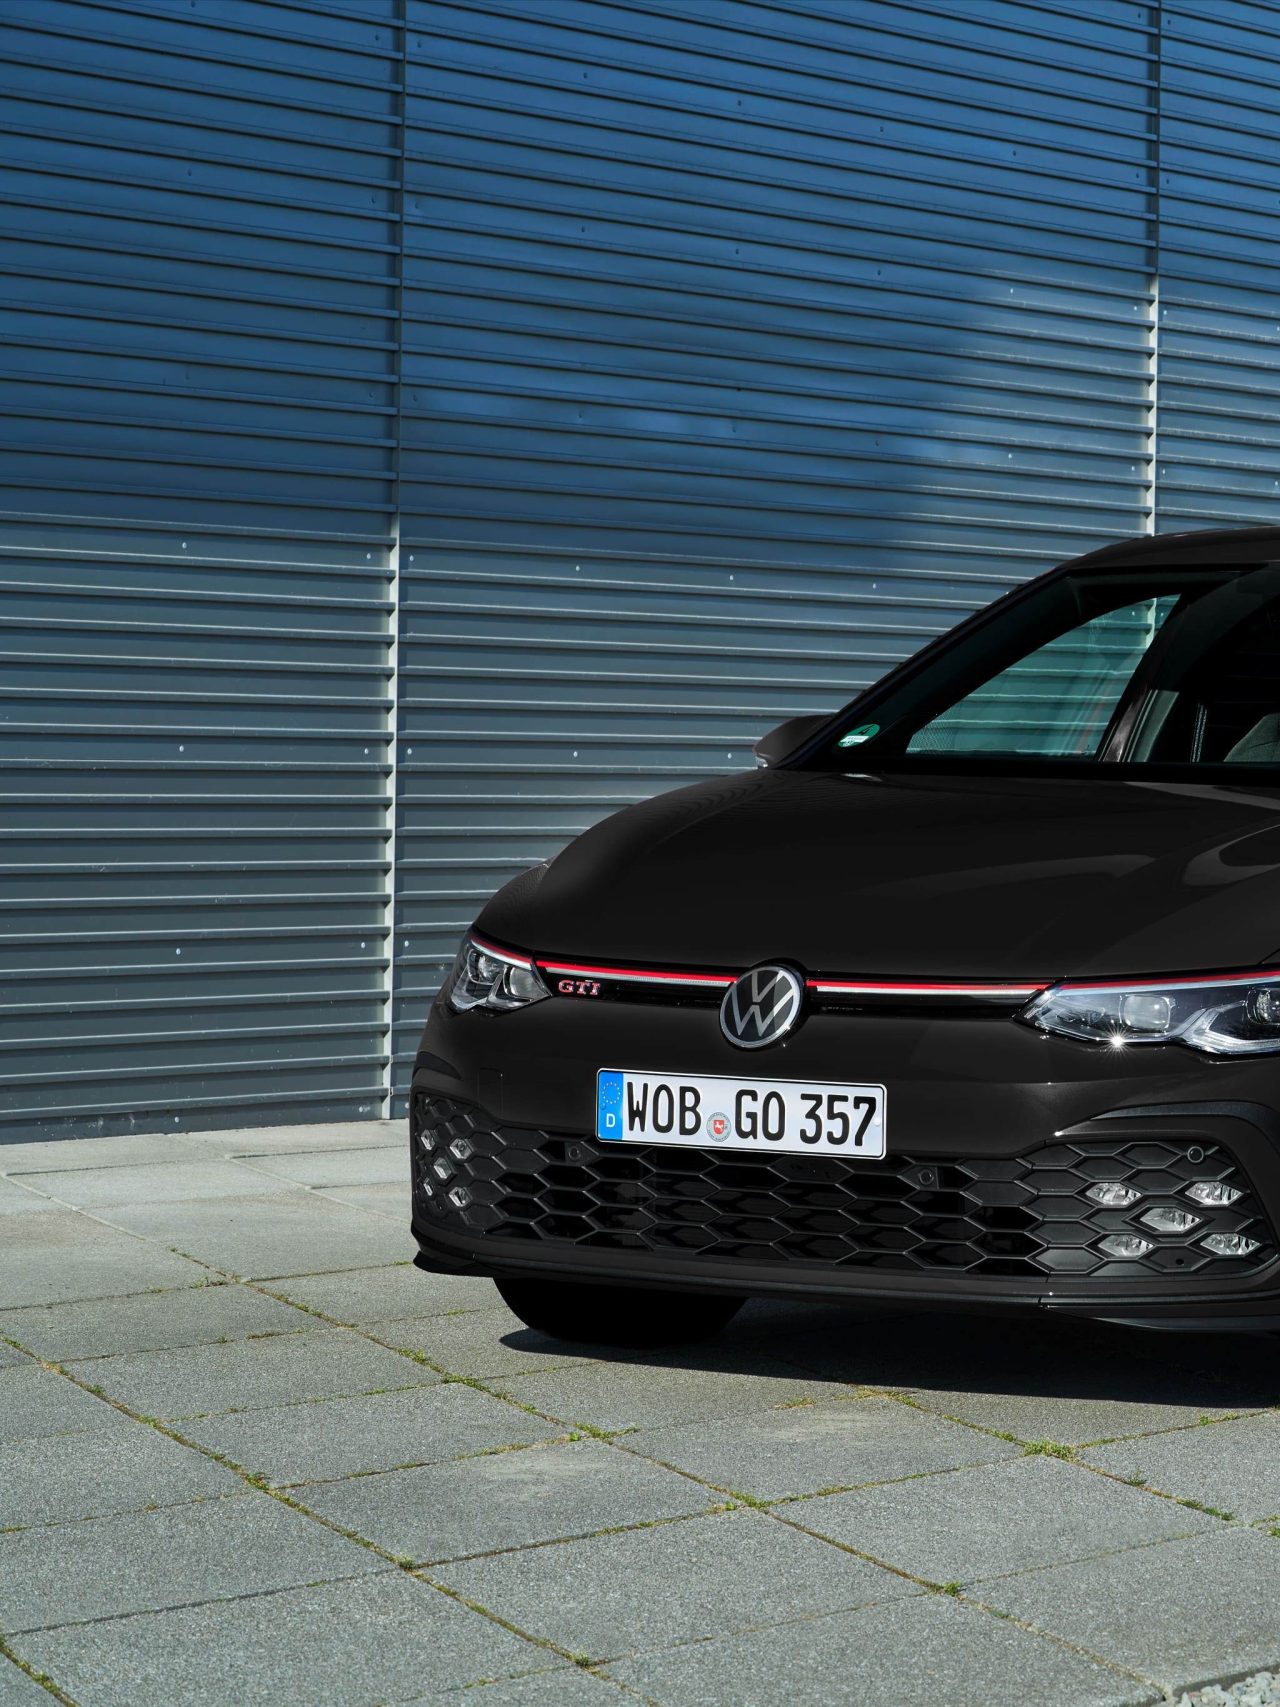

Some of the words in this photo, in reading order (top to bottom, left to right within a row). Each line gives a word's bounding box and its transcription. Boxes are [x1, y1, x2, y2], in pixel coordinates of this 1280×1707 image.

[559, 980, 600, 995] GTI
[728, 968, 798, 1040] VW
[606, 1113, 615, 1128] D
[627, 1082, 701, 1135] WOB
[735, 1089, 786, 1141] GO
[800, 1094, 876, 1146] 357
